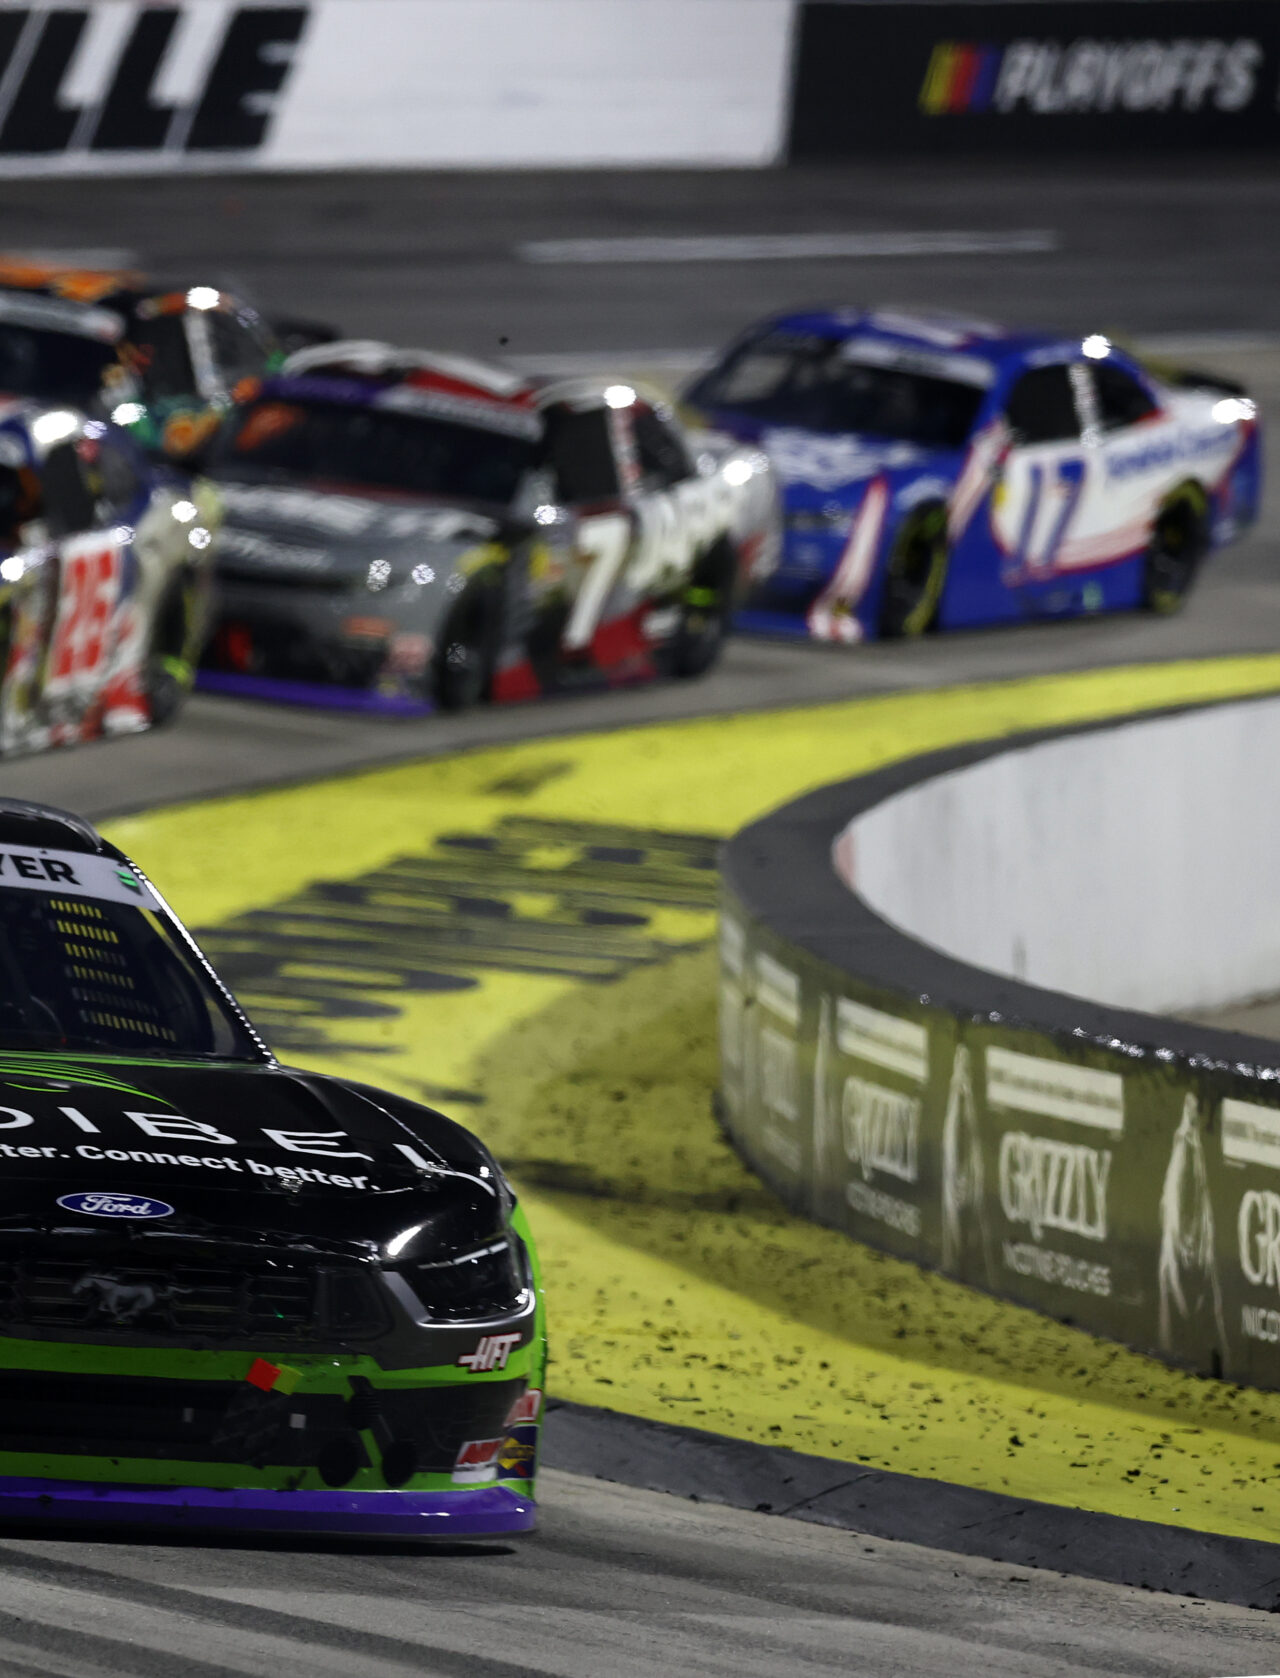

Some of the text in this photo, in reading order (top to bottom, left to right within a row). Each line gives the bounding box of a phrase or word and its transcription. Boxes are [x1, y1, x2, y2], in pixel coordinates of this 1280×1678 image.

[993, 38, 1264, 113] PLAYOFFS
[1016, 457, 1087, 566] 17
[565, 511, 630, 655] 7
[75, 1145, 242, 1172] Connect
[248, 1157, 381, 1191] better.
[80, 1193, 152, 1216] Ford
[999, 1130, 1112, 1242] GRIZZLY
